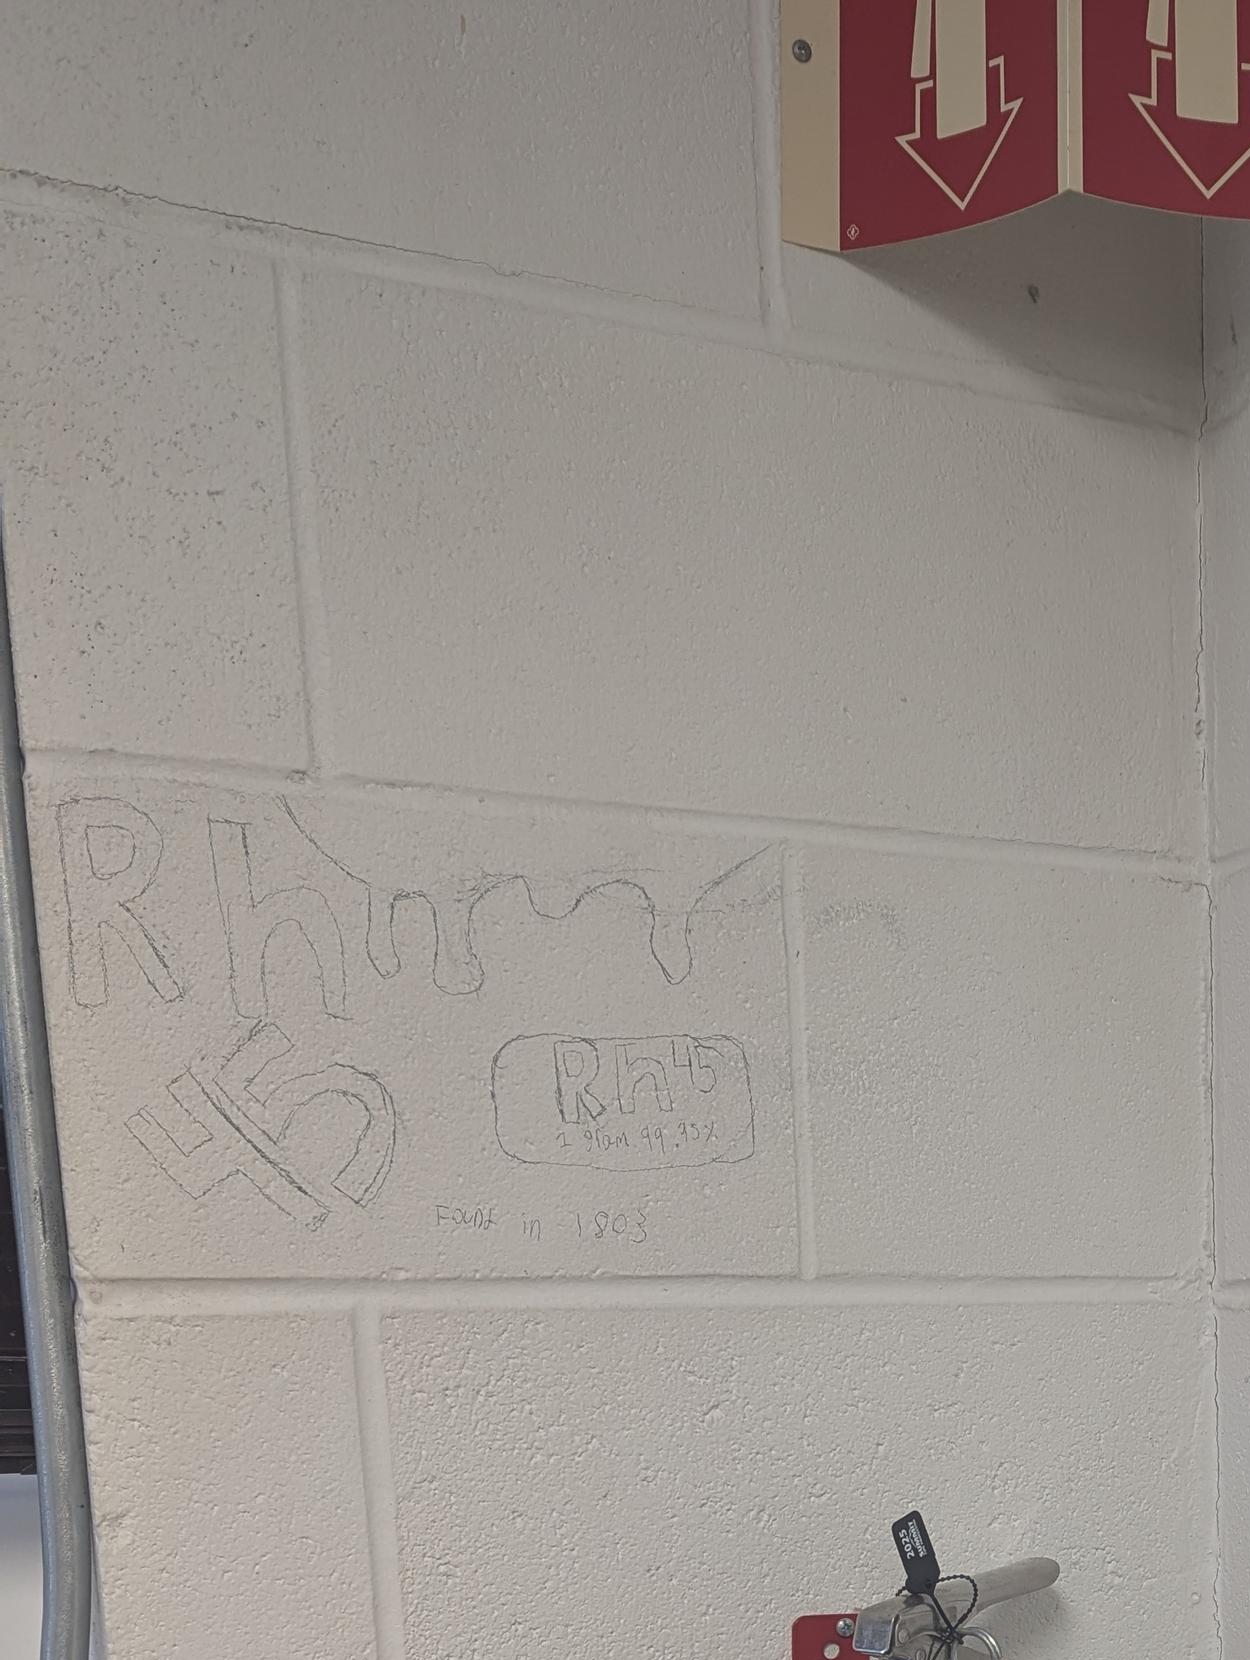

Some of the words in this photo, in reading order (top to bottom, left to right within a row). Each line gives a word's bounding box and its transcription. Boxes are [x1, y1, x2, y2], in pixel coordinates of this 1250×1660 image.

[521, 1212, 541, 1241] in
[576, 1210, 648, 1243] 1803
[898, 1529, 915, 1559] 2025
